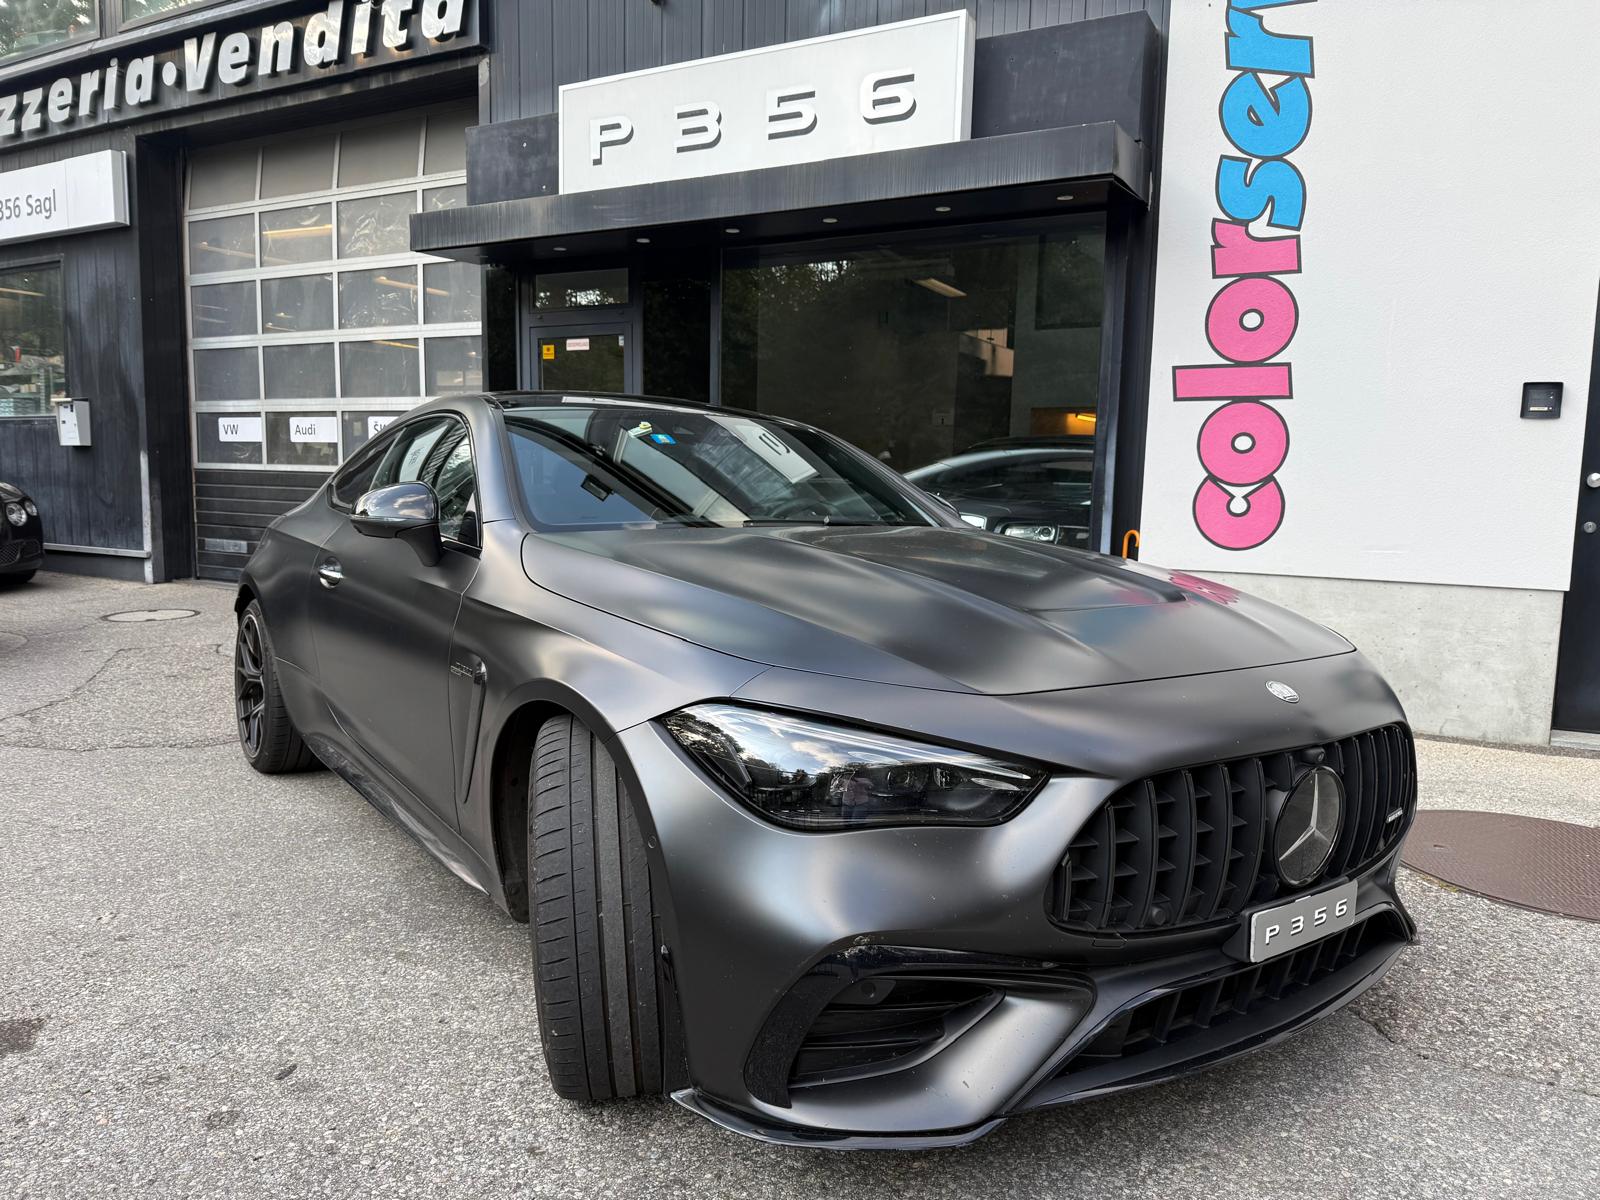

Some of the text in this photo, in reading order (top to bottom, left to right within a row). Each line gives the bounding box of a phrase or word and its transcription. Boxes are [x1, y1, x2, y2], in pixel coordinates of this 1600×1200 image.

[0, 55, 156, 136] zzeria
[26, 188, 57, 220] Sagl
[1172, 0, 1318, 551] colorser
[222, 424, 239, 435] VW
[295, 424, 316, 435] Audi
